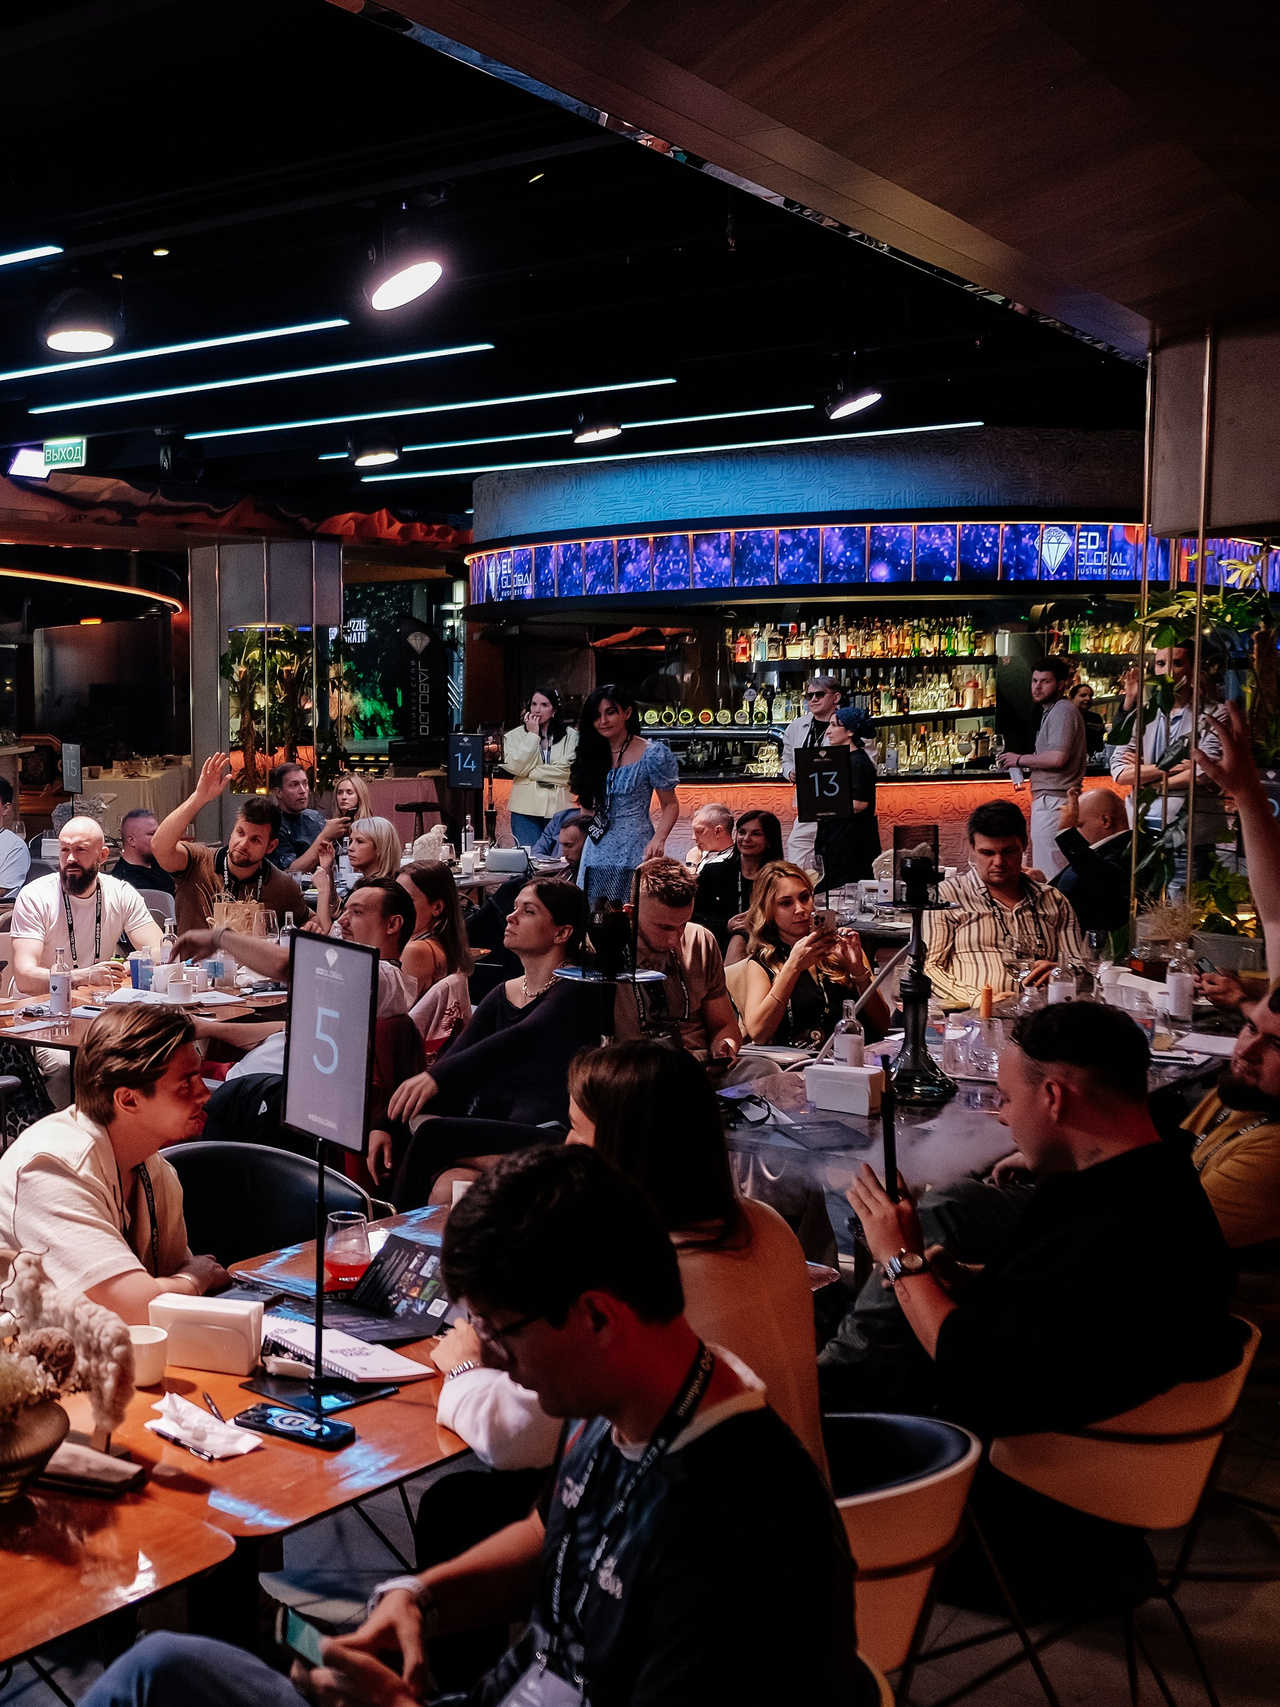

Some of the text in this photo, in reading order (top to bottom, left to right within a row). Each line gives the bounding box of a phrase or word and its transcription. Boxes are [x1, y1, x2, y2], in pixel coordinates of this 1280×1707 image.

[45, 446, 82, 462] ВЫХОД
[1078, 531, 1100, 550] ED
[1078, 551, 1127, 566] GLOBAL
[1078, 568, 1107, 576] USINES
[65, 759, 78, 777] 15
[454, 752, 477, 772] 14
[808, 771, 840, 797] 13
[312, 1006, 340, 1075] 5
